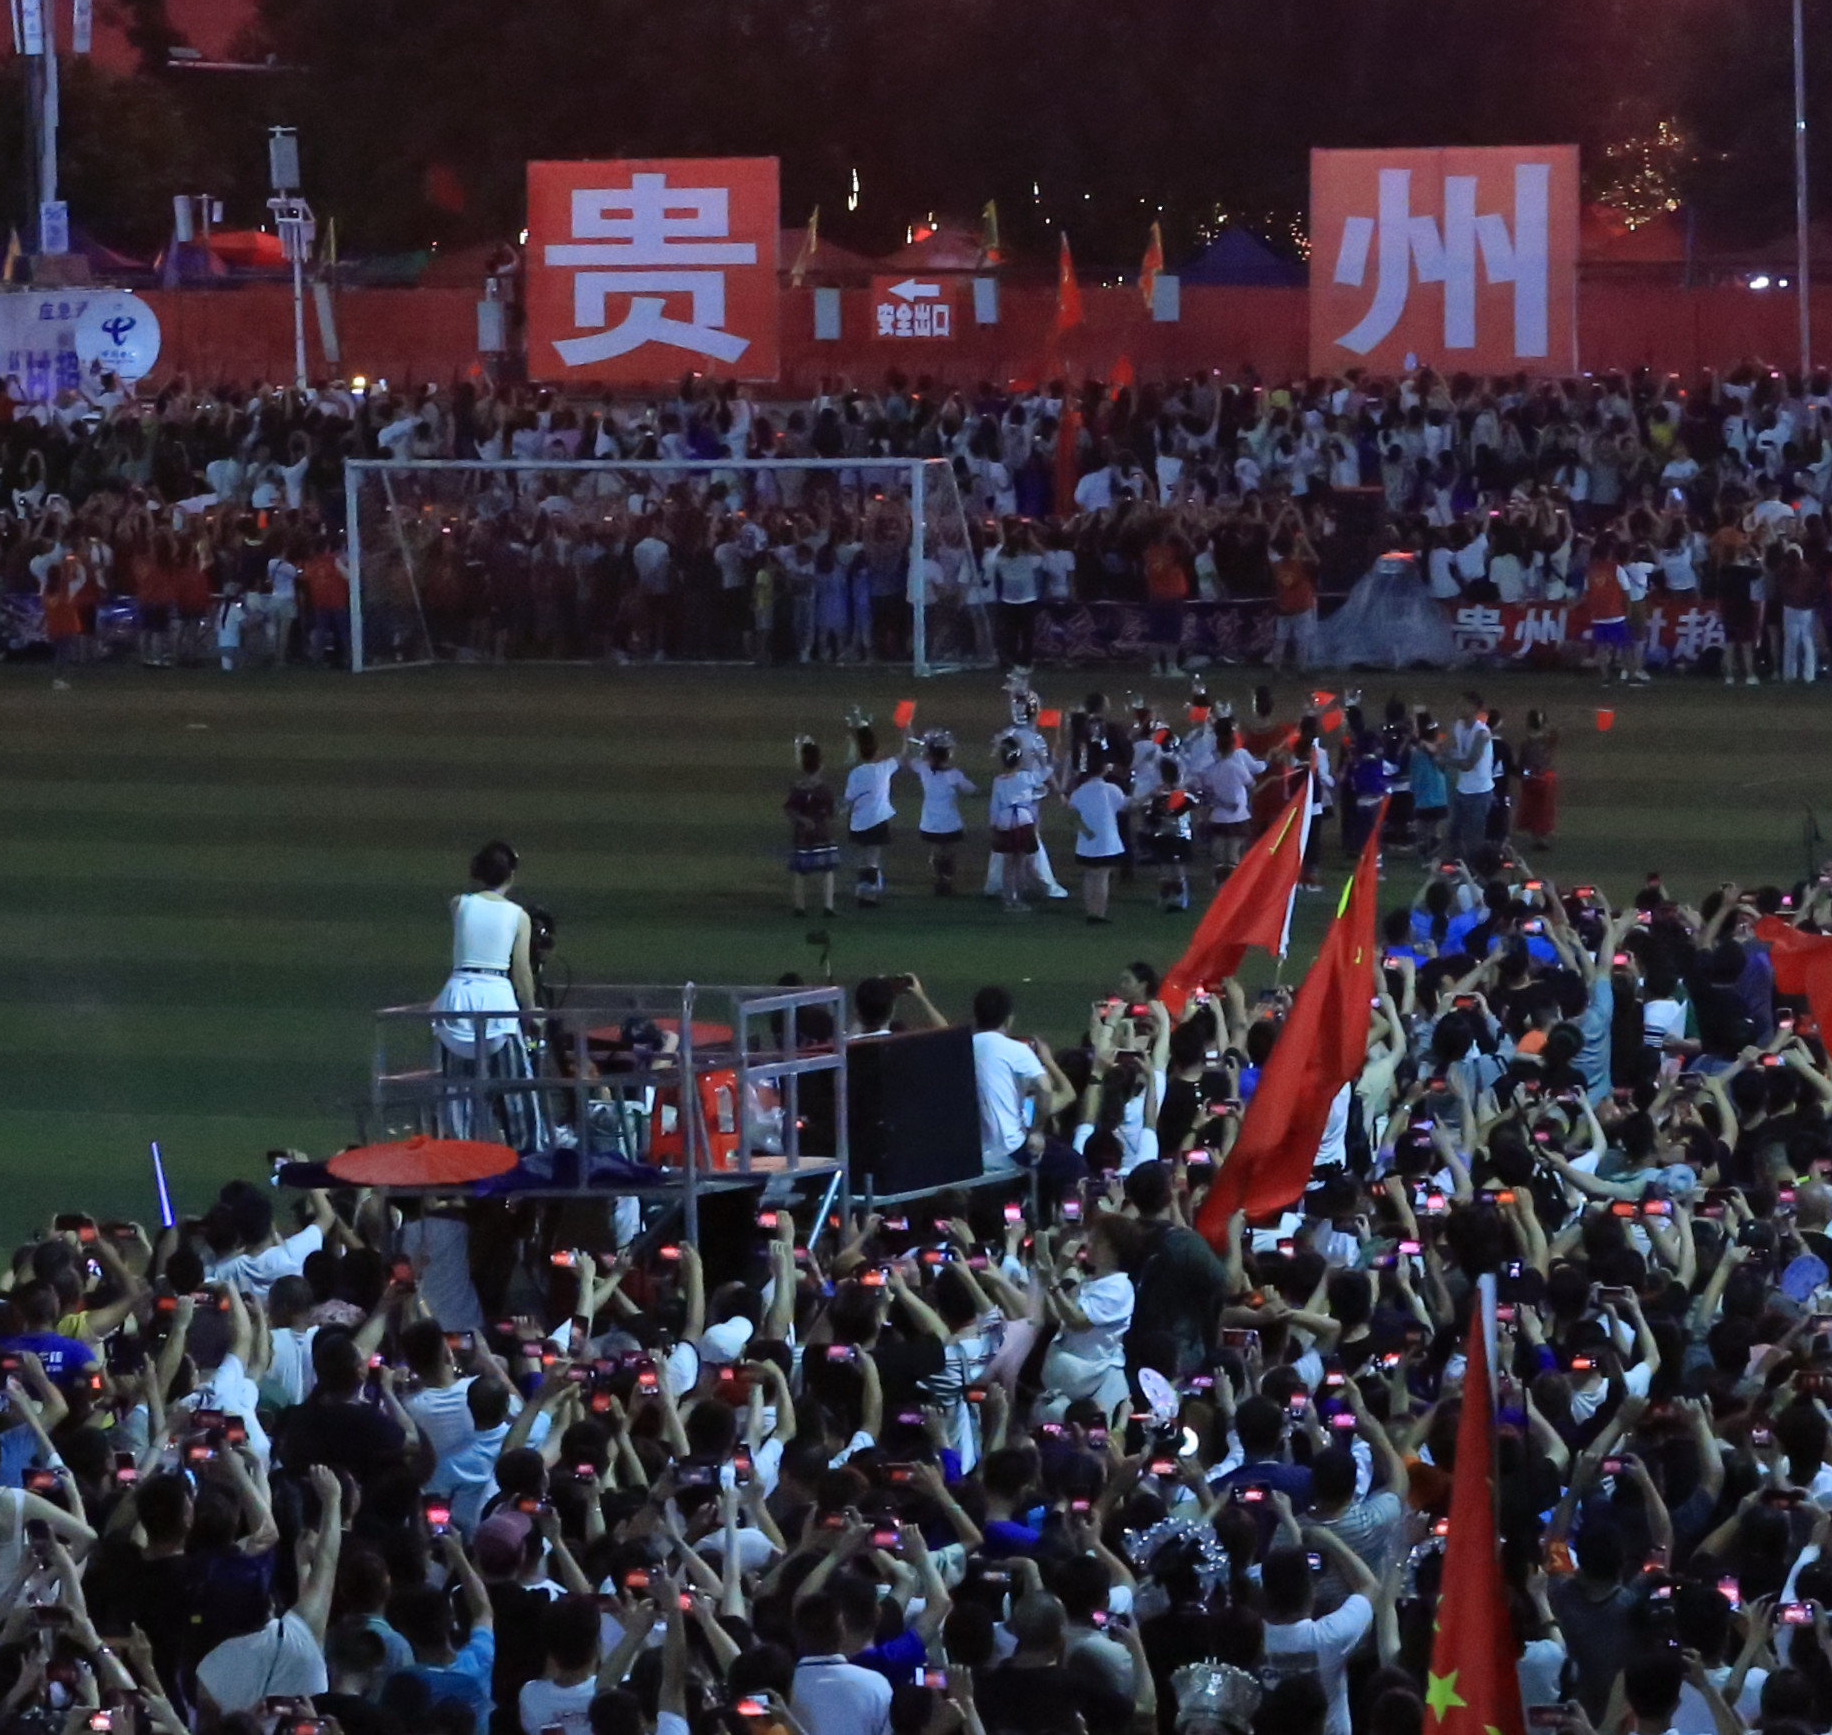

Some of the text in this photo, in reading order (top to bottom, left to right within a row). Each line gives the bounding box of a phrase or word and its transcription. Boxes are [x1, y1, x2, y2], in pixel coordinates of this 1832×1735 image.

[543, 172, 757, 368] 贵
[876, 302, 950, 337] 安全出口
[1333, 163, 1551, 359] 州
